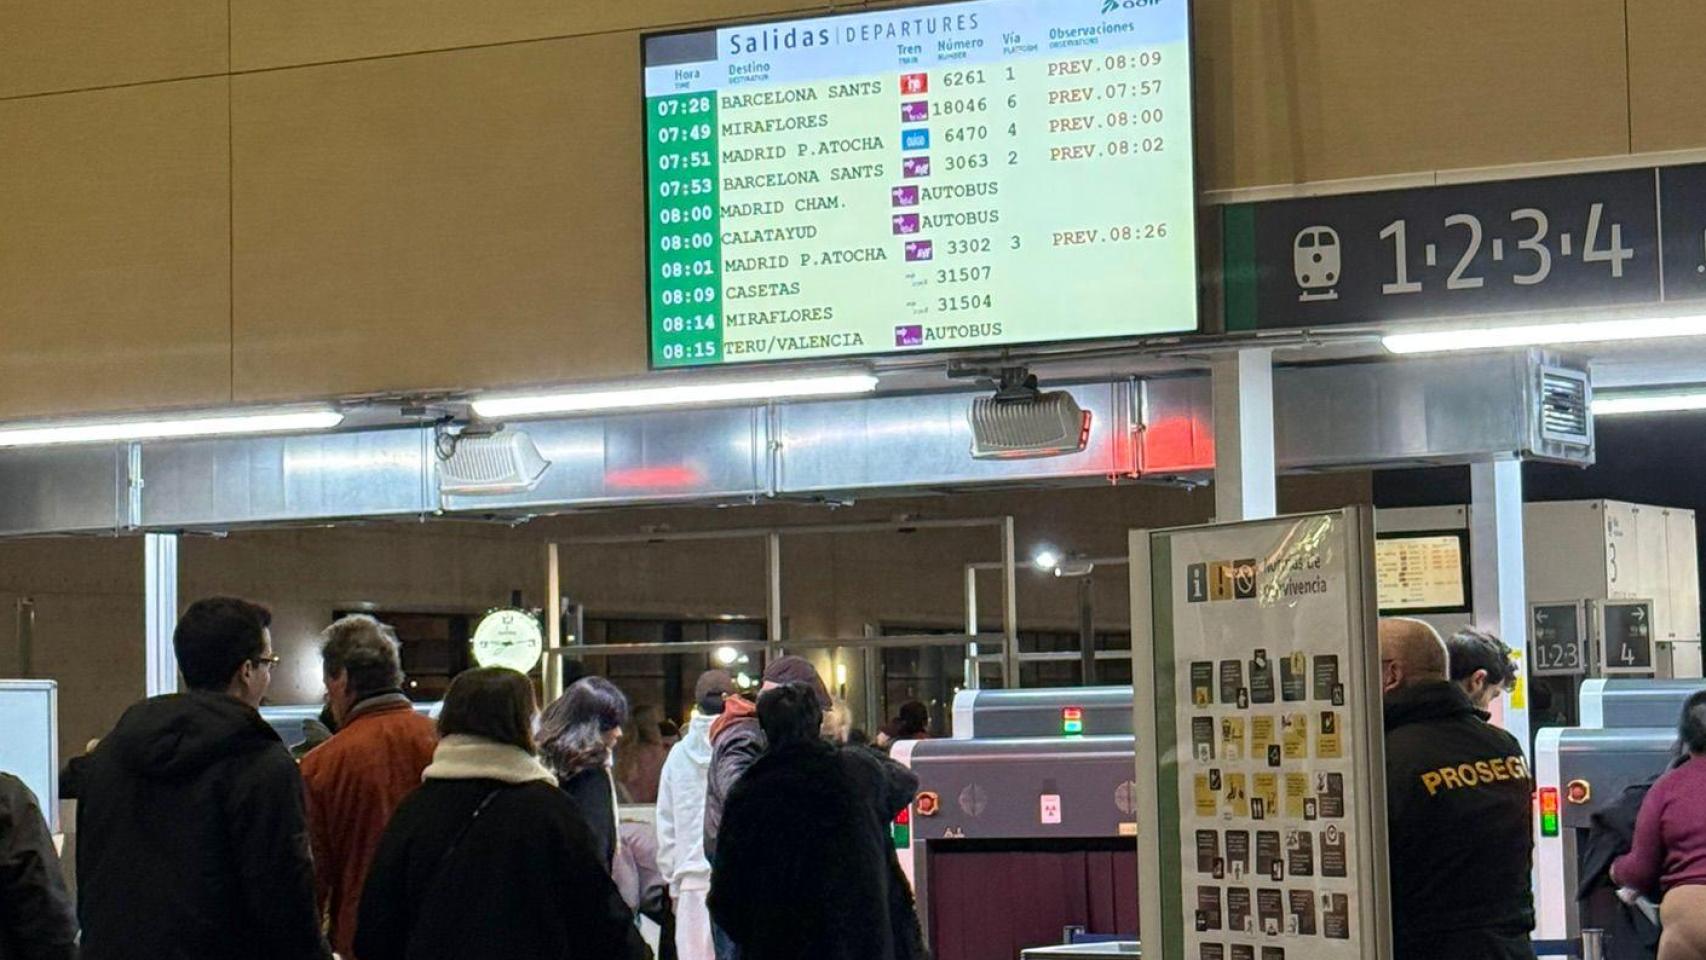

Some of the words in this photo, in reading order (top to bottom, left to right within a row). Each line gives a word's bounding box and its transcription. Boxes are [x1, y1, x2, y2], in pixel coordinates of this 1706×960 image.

[674, 68, 701, 81] Hora
[728, 61, 771, 76] Destino
[897, 43, 922, 55] Tren
[937, 38, 984, 52] Número
[1002, 31, 1021, 45] Vía
[1049, 21, 1135, 40] Observaciones
[730, 27, 830, 55] Salidas
[845, 12, 979, 43] DEPARTURES
[657, 97, 711, 117] 07:28
[721, 87, 818, 110] BARCELONA
[828, 80, 883, 99] SANTS
[943, 69, 986, 87] 6261
[1005, 66, 1016, 81] 1
[1047, 51, 1162, 77] PREV.08:09
[658, 124, 711, 143] 07:49
[721, 113, 829, 137] MIRAFLORES
[932, 97, 988, 116] 18046
[1007, 94, 1017, 109] 6
[1048, 79, 1162, 105] PREV.07:57
[658, 151, 712, 170] 07:51
[721, 145, 787, 164] MADRID
[797, 136, 885, 156] P.ATOCHA
[944, 125, 988, 143] 6470
[1007, 122, 1017, 137] 4
[1049, 108, 1164, 133] PREV.08:00
[659, 178, 713, 198] 07:53
[723, 170, 820, 191] BARCELONA
[830, 163, 885, 182] SANTS
[944, 153, 988, 171] 3063
[1007, 150, 1019, 165] 2
[1050, 136, 1164, 161] PREV.08:02
[659, 205, 713, 225] 08:00
[719, 199, 785, 218] MADRID
[794, 194, 847, 211] CHAM.
[921, 181, 999, 201] AUTOBUS
[660, 233, 714, 251] 08:00
[720, 225, 818, 246] CALATAYUD
[921, 209, 1000, 229] AUTOBUS
[661, 259, 714, 279] 08:01
[724, 254, 789, 273] MADRID
[799, 246, 888, 267] P.ATOCHA
[947, 238, 991, 255] 3302
[1010, 235, 1021, 250] 3
[1052, 222, 1168, 247] PREV.08:26
[661, 286, 716, 305] 08:09
[725, 281, 801, 301] CASETAS
[937, 265, 992, 284] 31507
[662, 314, 716, 333] 08:14
[726, 306, 834, 329] MIRAFLORES
[938, 294, 992, 312] 31504
[663, 341, 716, 360] 08:15
[723, 332, 865, 356] TERU/VALENCIA
[924, 322, 1003, 341] AUTOBUS
[1620, 642, 1635, 666] 4
